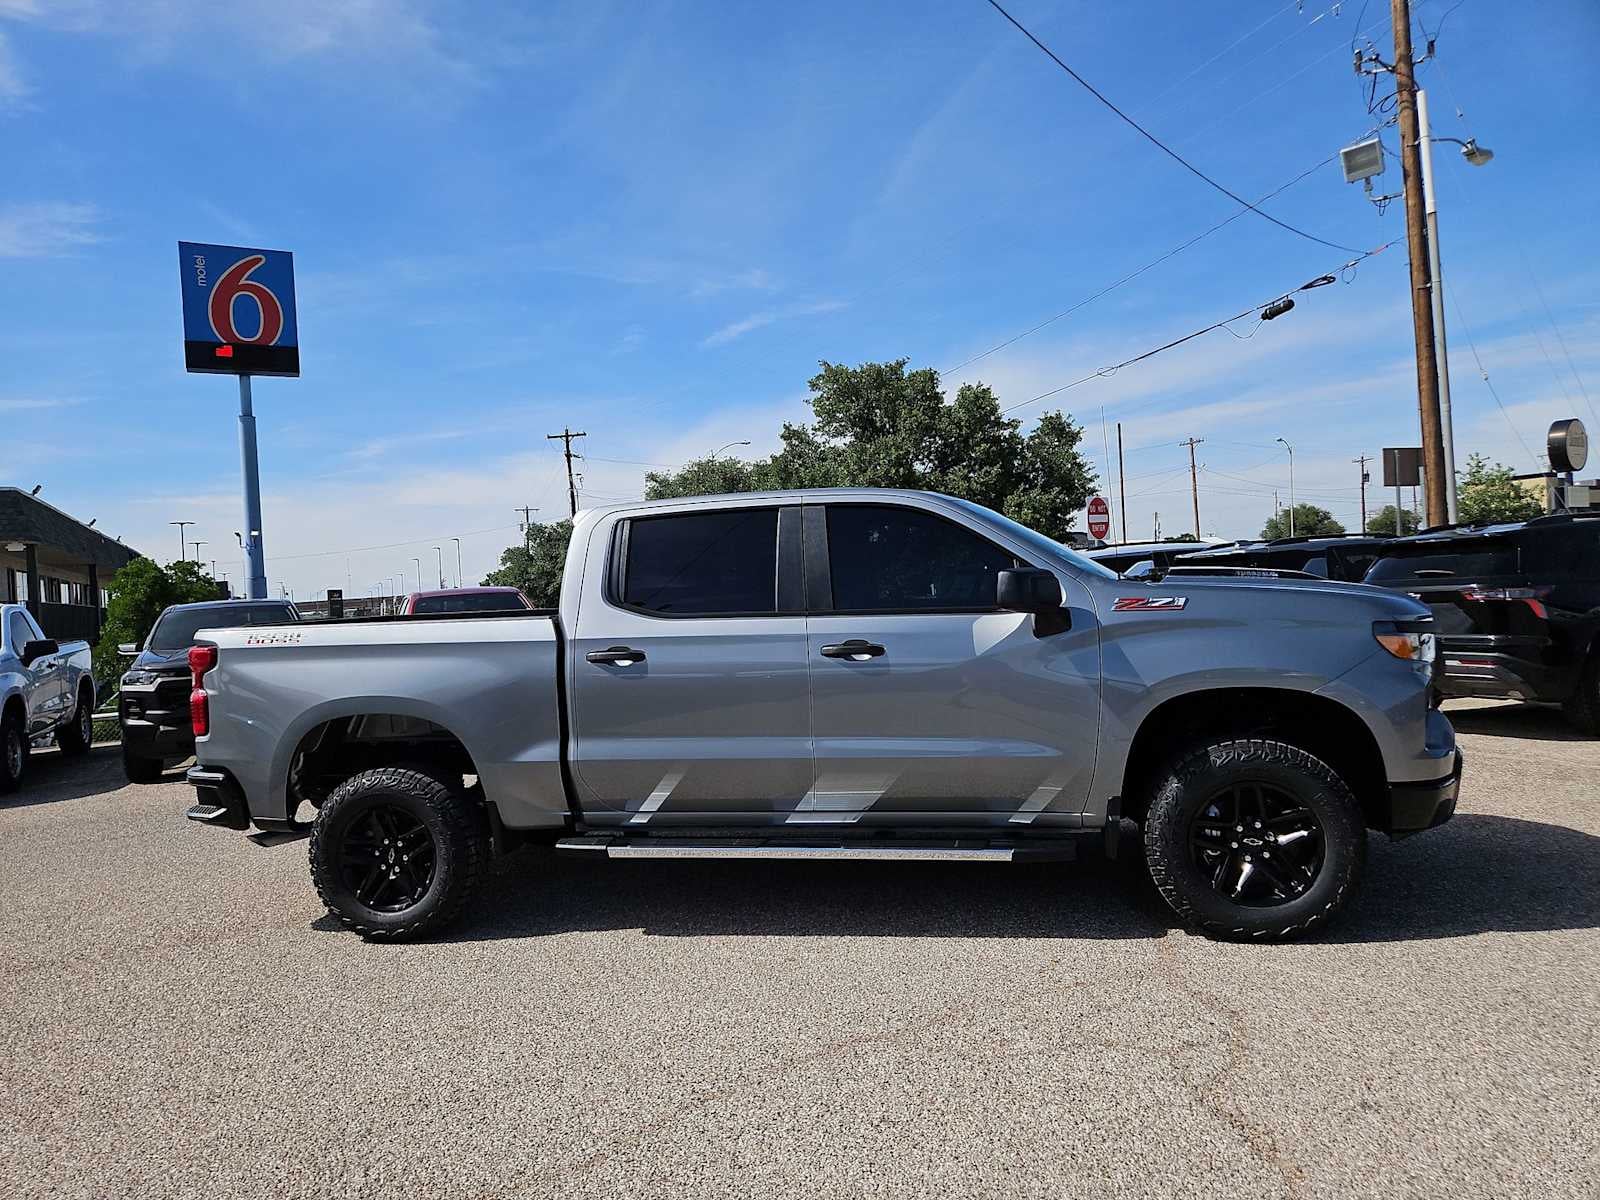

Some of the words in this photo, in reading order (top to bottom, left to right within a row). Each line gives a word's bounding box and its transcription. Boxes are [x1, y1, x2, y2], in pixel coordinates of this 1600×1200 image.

[194, 255, 207, 286] motel
[208, 254, 284, 346] 6
[1090, 505, 1096, 513] DO
[1098, 505, 1106, 513] NOT
[1092, 524, 1105, 532] ENTER
